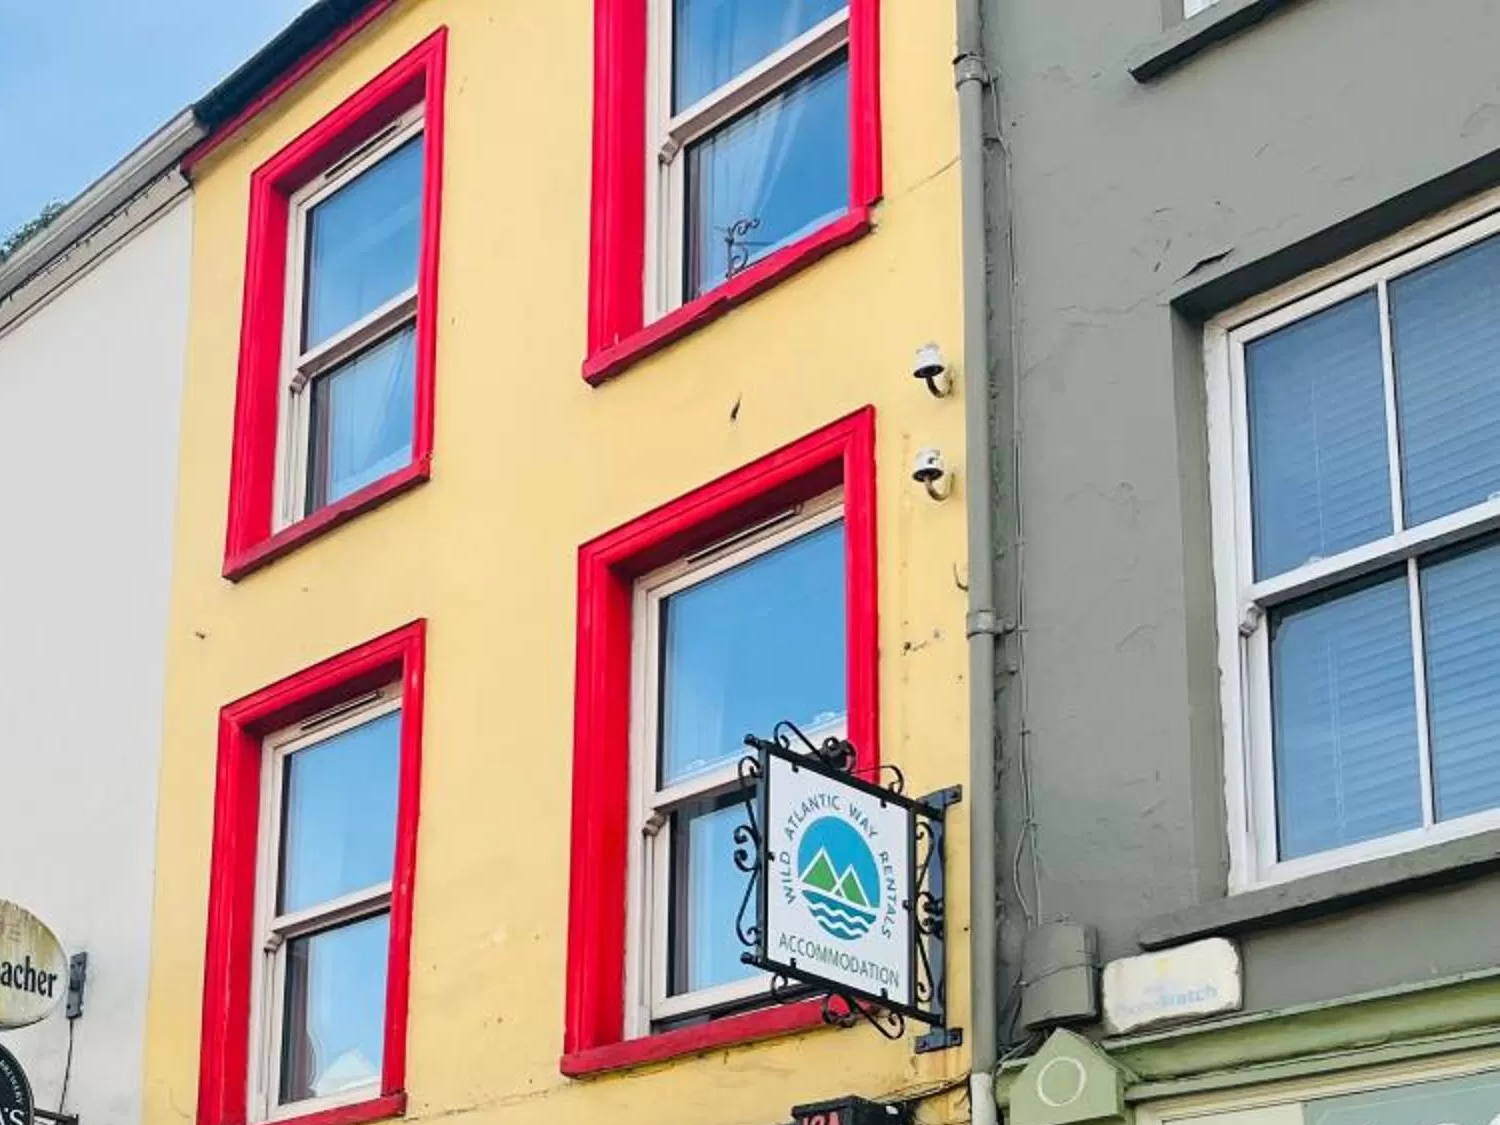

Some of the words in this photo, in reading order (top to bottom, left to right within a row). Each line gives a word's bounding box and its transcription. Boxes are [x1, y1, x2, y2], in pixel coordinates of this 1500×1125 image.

[784, 793, 841, 840] ATLANTIC
[849, 804, 878, 838] WAY
[780, 852, 796, 905] WILD
[879, 851, 897, 939] RENTALS
[779, 932, 900, 987] ACCOMMODATION
